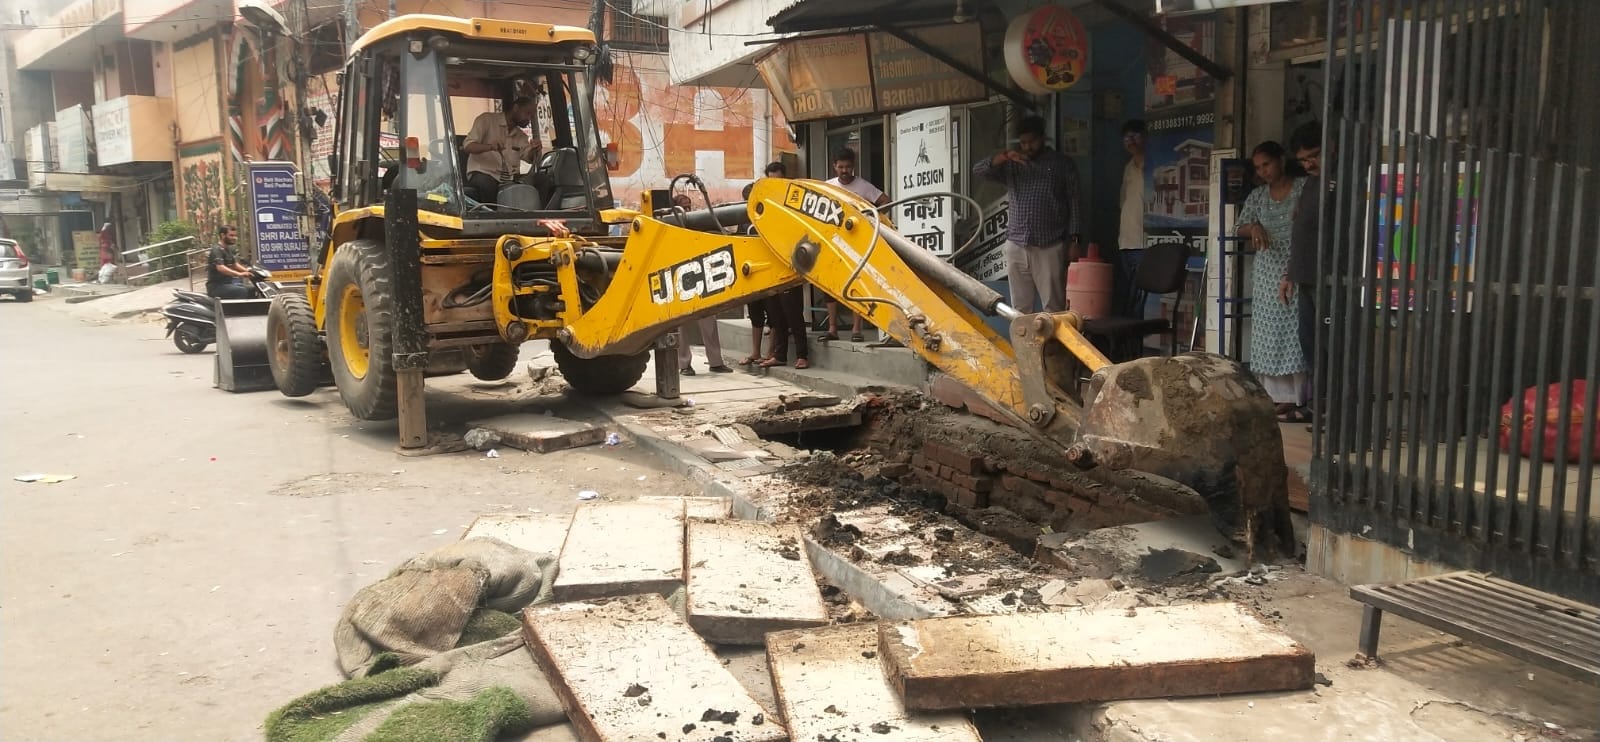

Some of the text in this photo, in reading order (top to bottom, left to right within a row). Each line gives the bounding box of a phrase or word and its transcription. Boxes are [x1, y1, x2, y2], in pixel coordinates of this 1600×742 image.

[917, 168, 944, 187] DESIGN
[260, 231, 279, 241] SHRI
[652, 250, 737, 305] JCB
